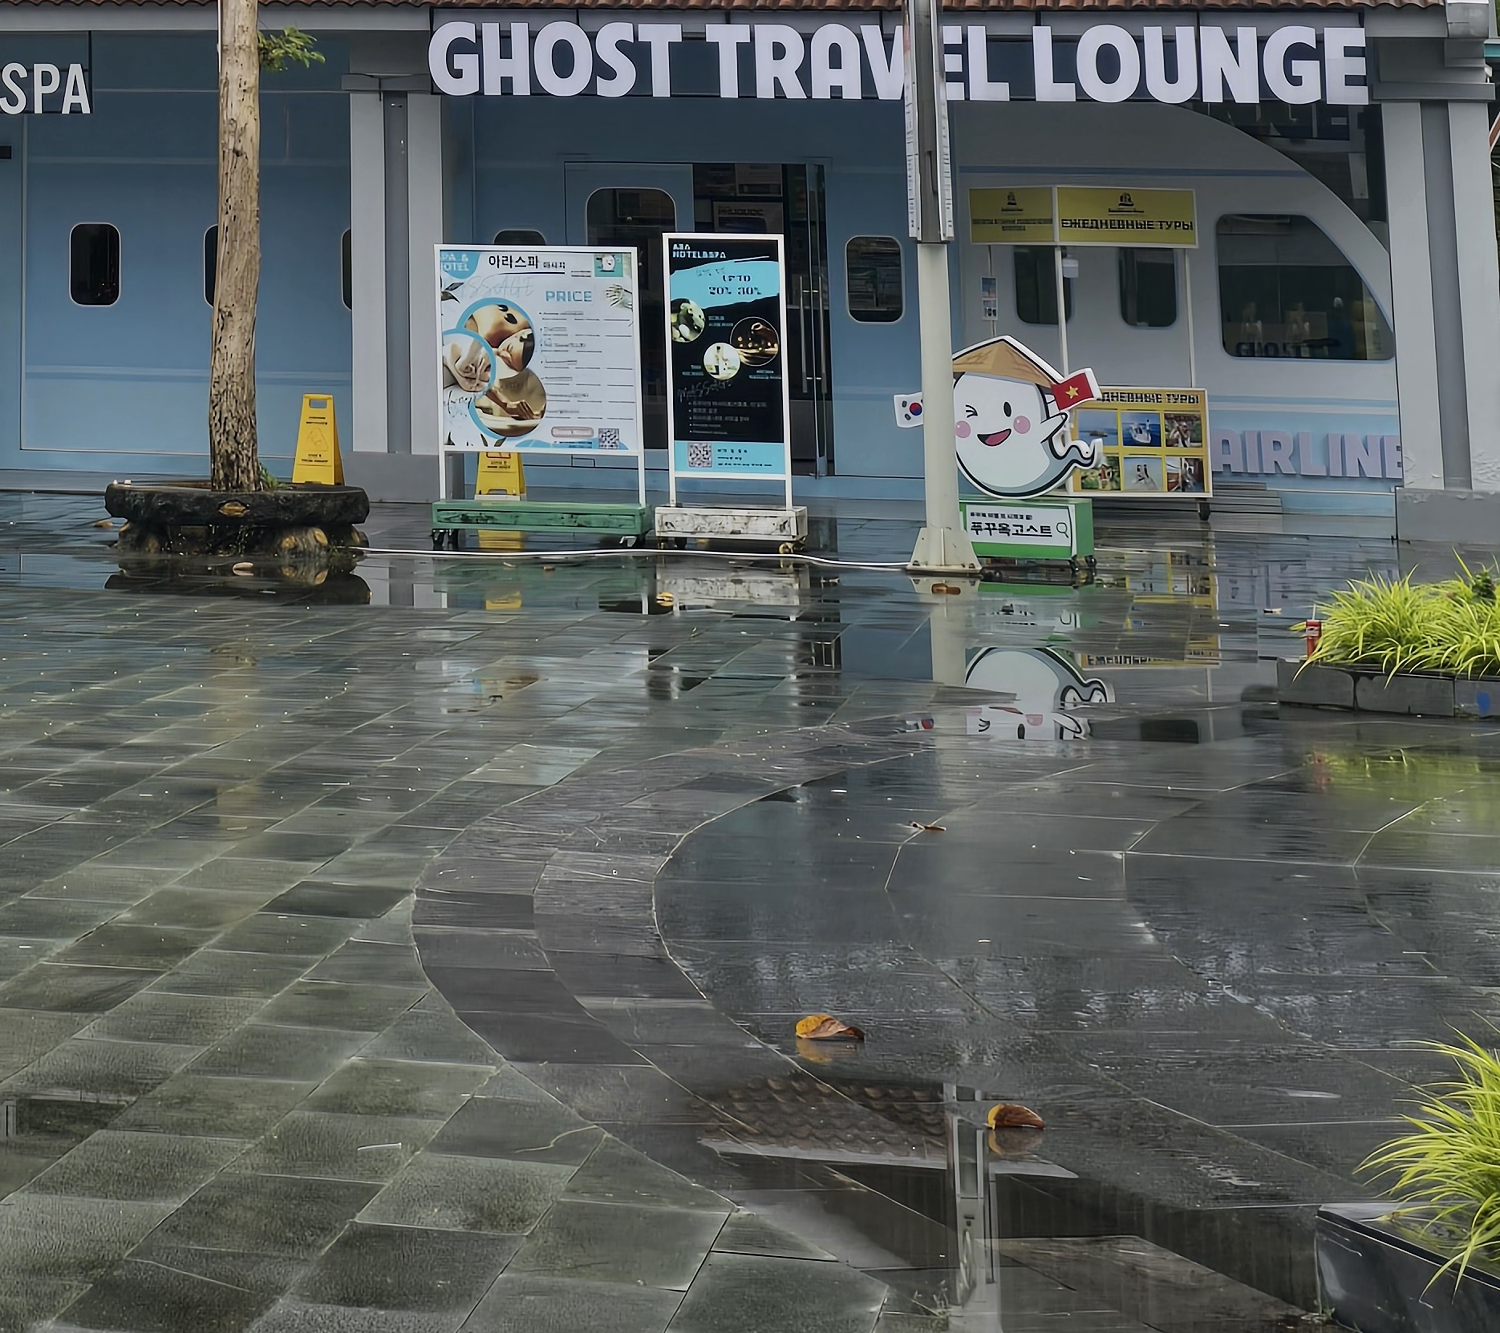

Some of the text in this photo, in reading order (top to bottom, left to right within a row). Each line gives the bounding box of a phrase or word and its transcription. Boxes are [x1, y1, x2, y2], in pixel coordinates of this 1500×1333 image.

[428, 20, 1369, 105] GHOST TRAVEL LOUNGE
[1061, 218, 1154, 230] ЕЖЕДНЕВНЫЕ
[1158, 220, 1194, 231] ТУРЫ
[545, 291, 592, 302] PRICE
